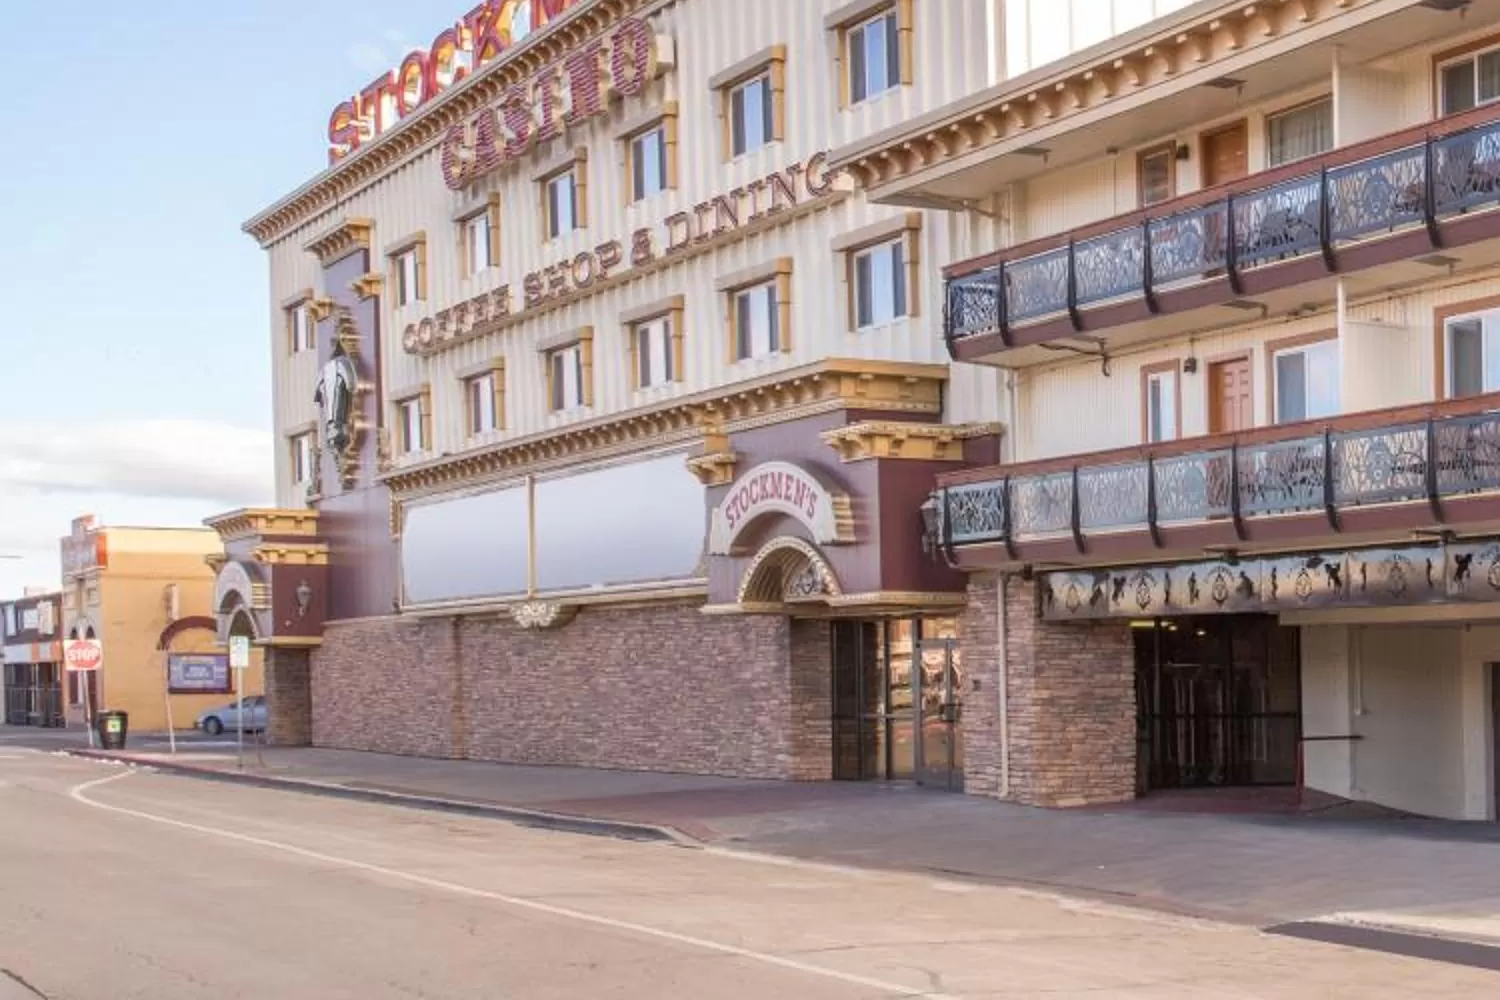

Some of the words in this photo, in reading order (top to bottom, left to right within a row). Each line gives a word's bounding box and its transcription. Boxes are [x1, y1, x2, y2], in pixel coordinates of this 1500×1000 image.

[441, 17, 660, 191] CASINO
[403, 285, 510, 355] COFFEE
[523, 240, 622, 302] SHOP
[631, 228, 656, 267] &
[664, 151, 834, 252] DINING
[725, 471, 818, 530] STOCKMEN'S
[67, 649, 100, 661] STOP
